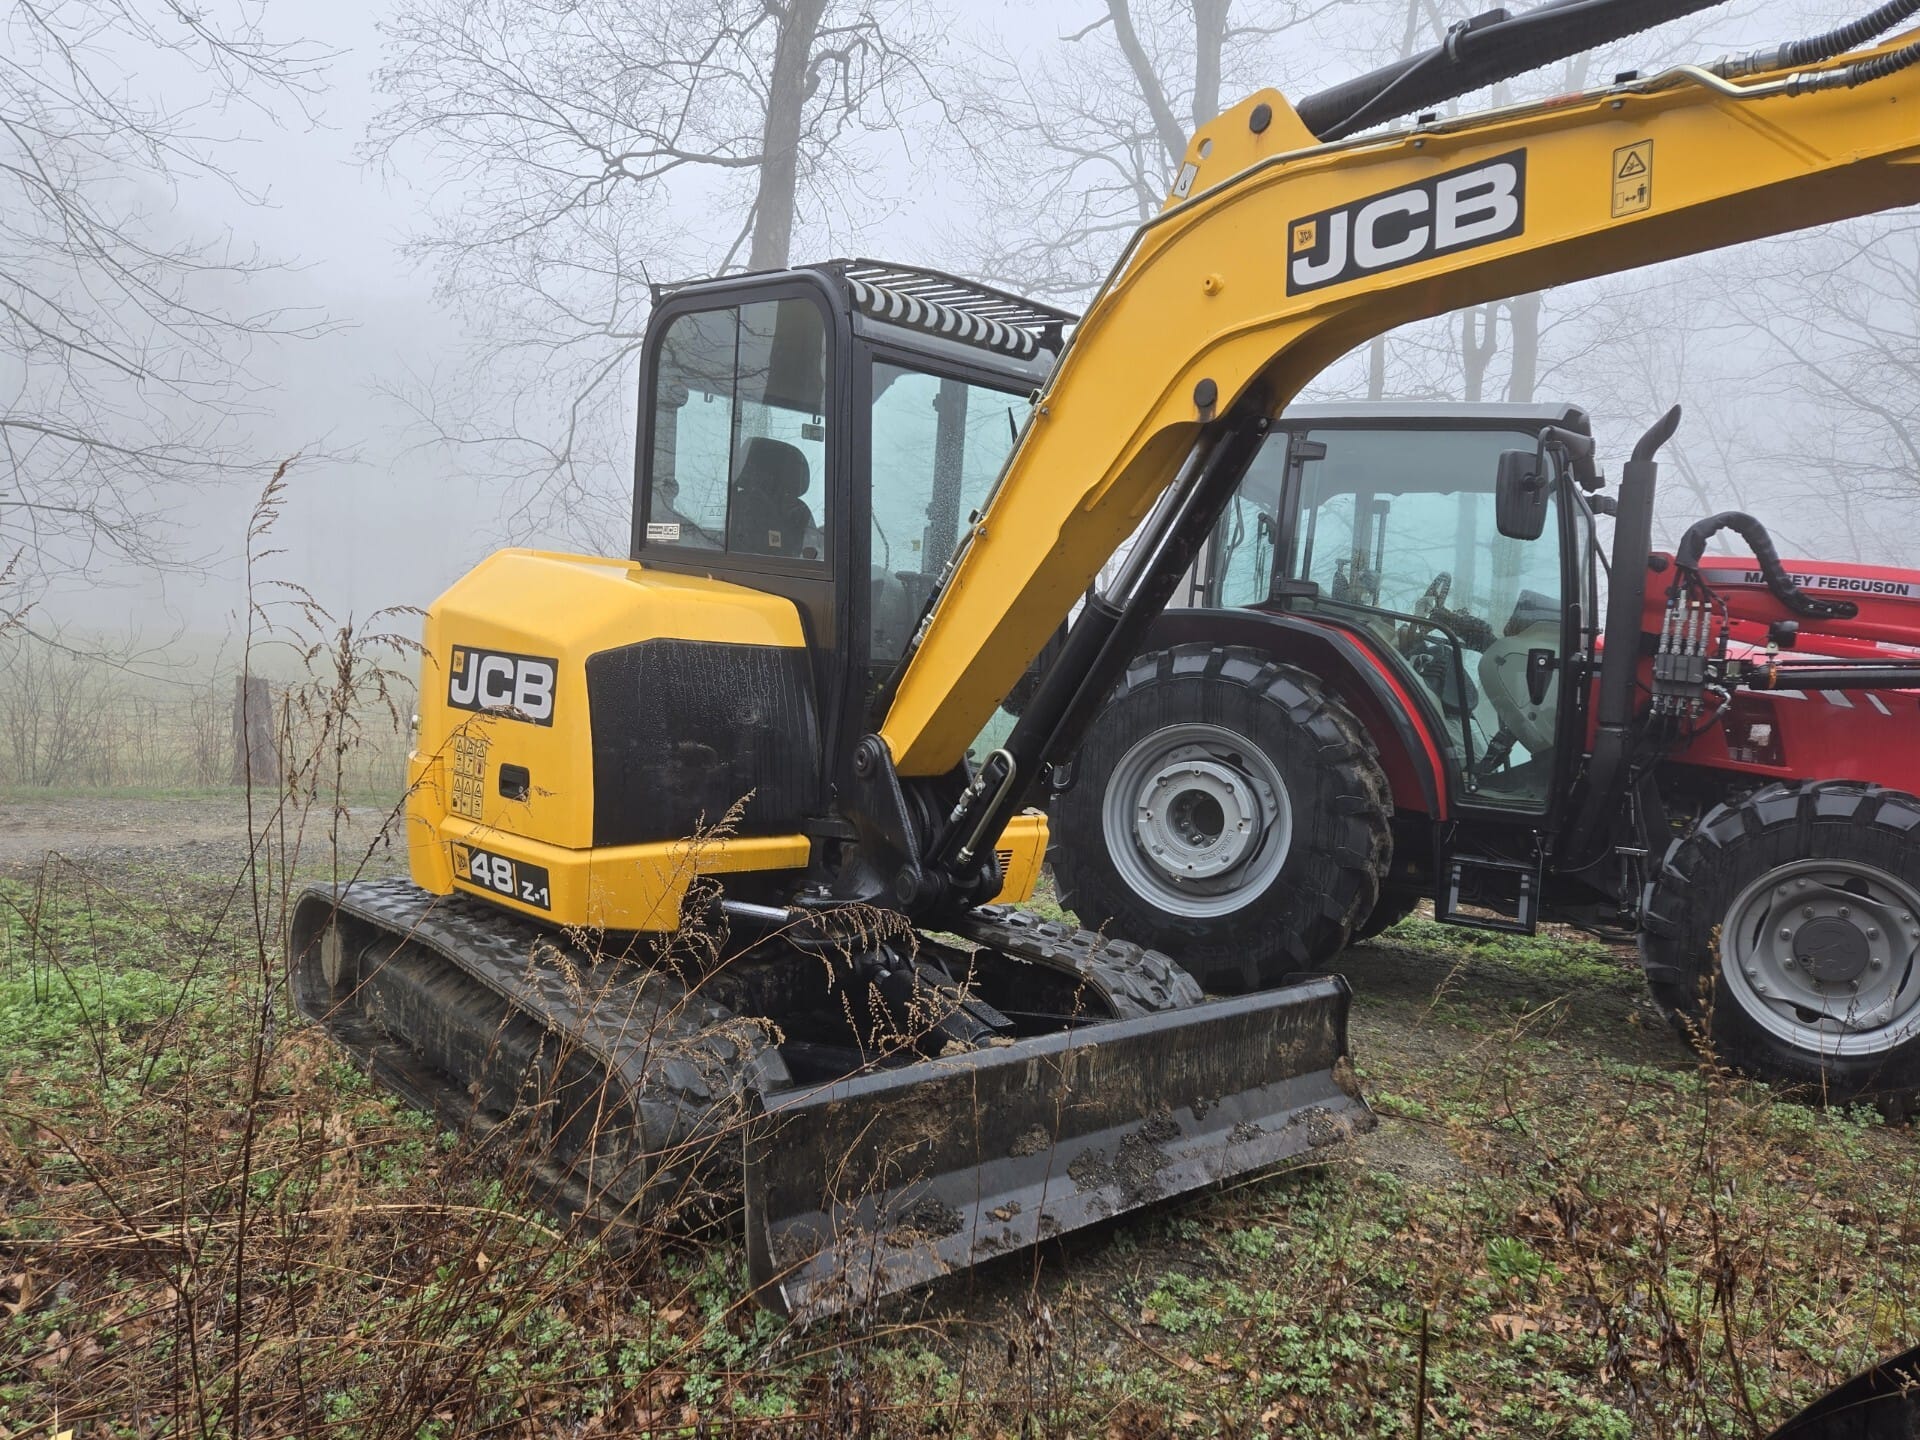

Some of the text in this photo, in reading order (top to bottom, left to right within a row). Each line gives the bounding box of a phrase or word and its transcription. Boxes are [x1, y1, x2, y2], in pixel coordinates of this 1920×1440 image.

[1292, 162, 1519, 286] JCB
[1744, 572, 1910, 596] MEY FERGUSON
[450, 652, 554, 720] JCB
[470, 852, 514, 894] 48
